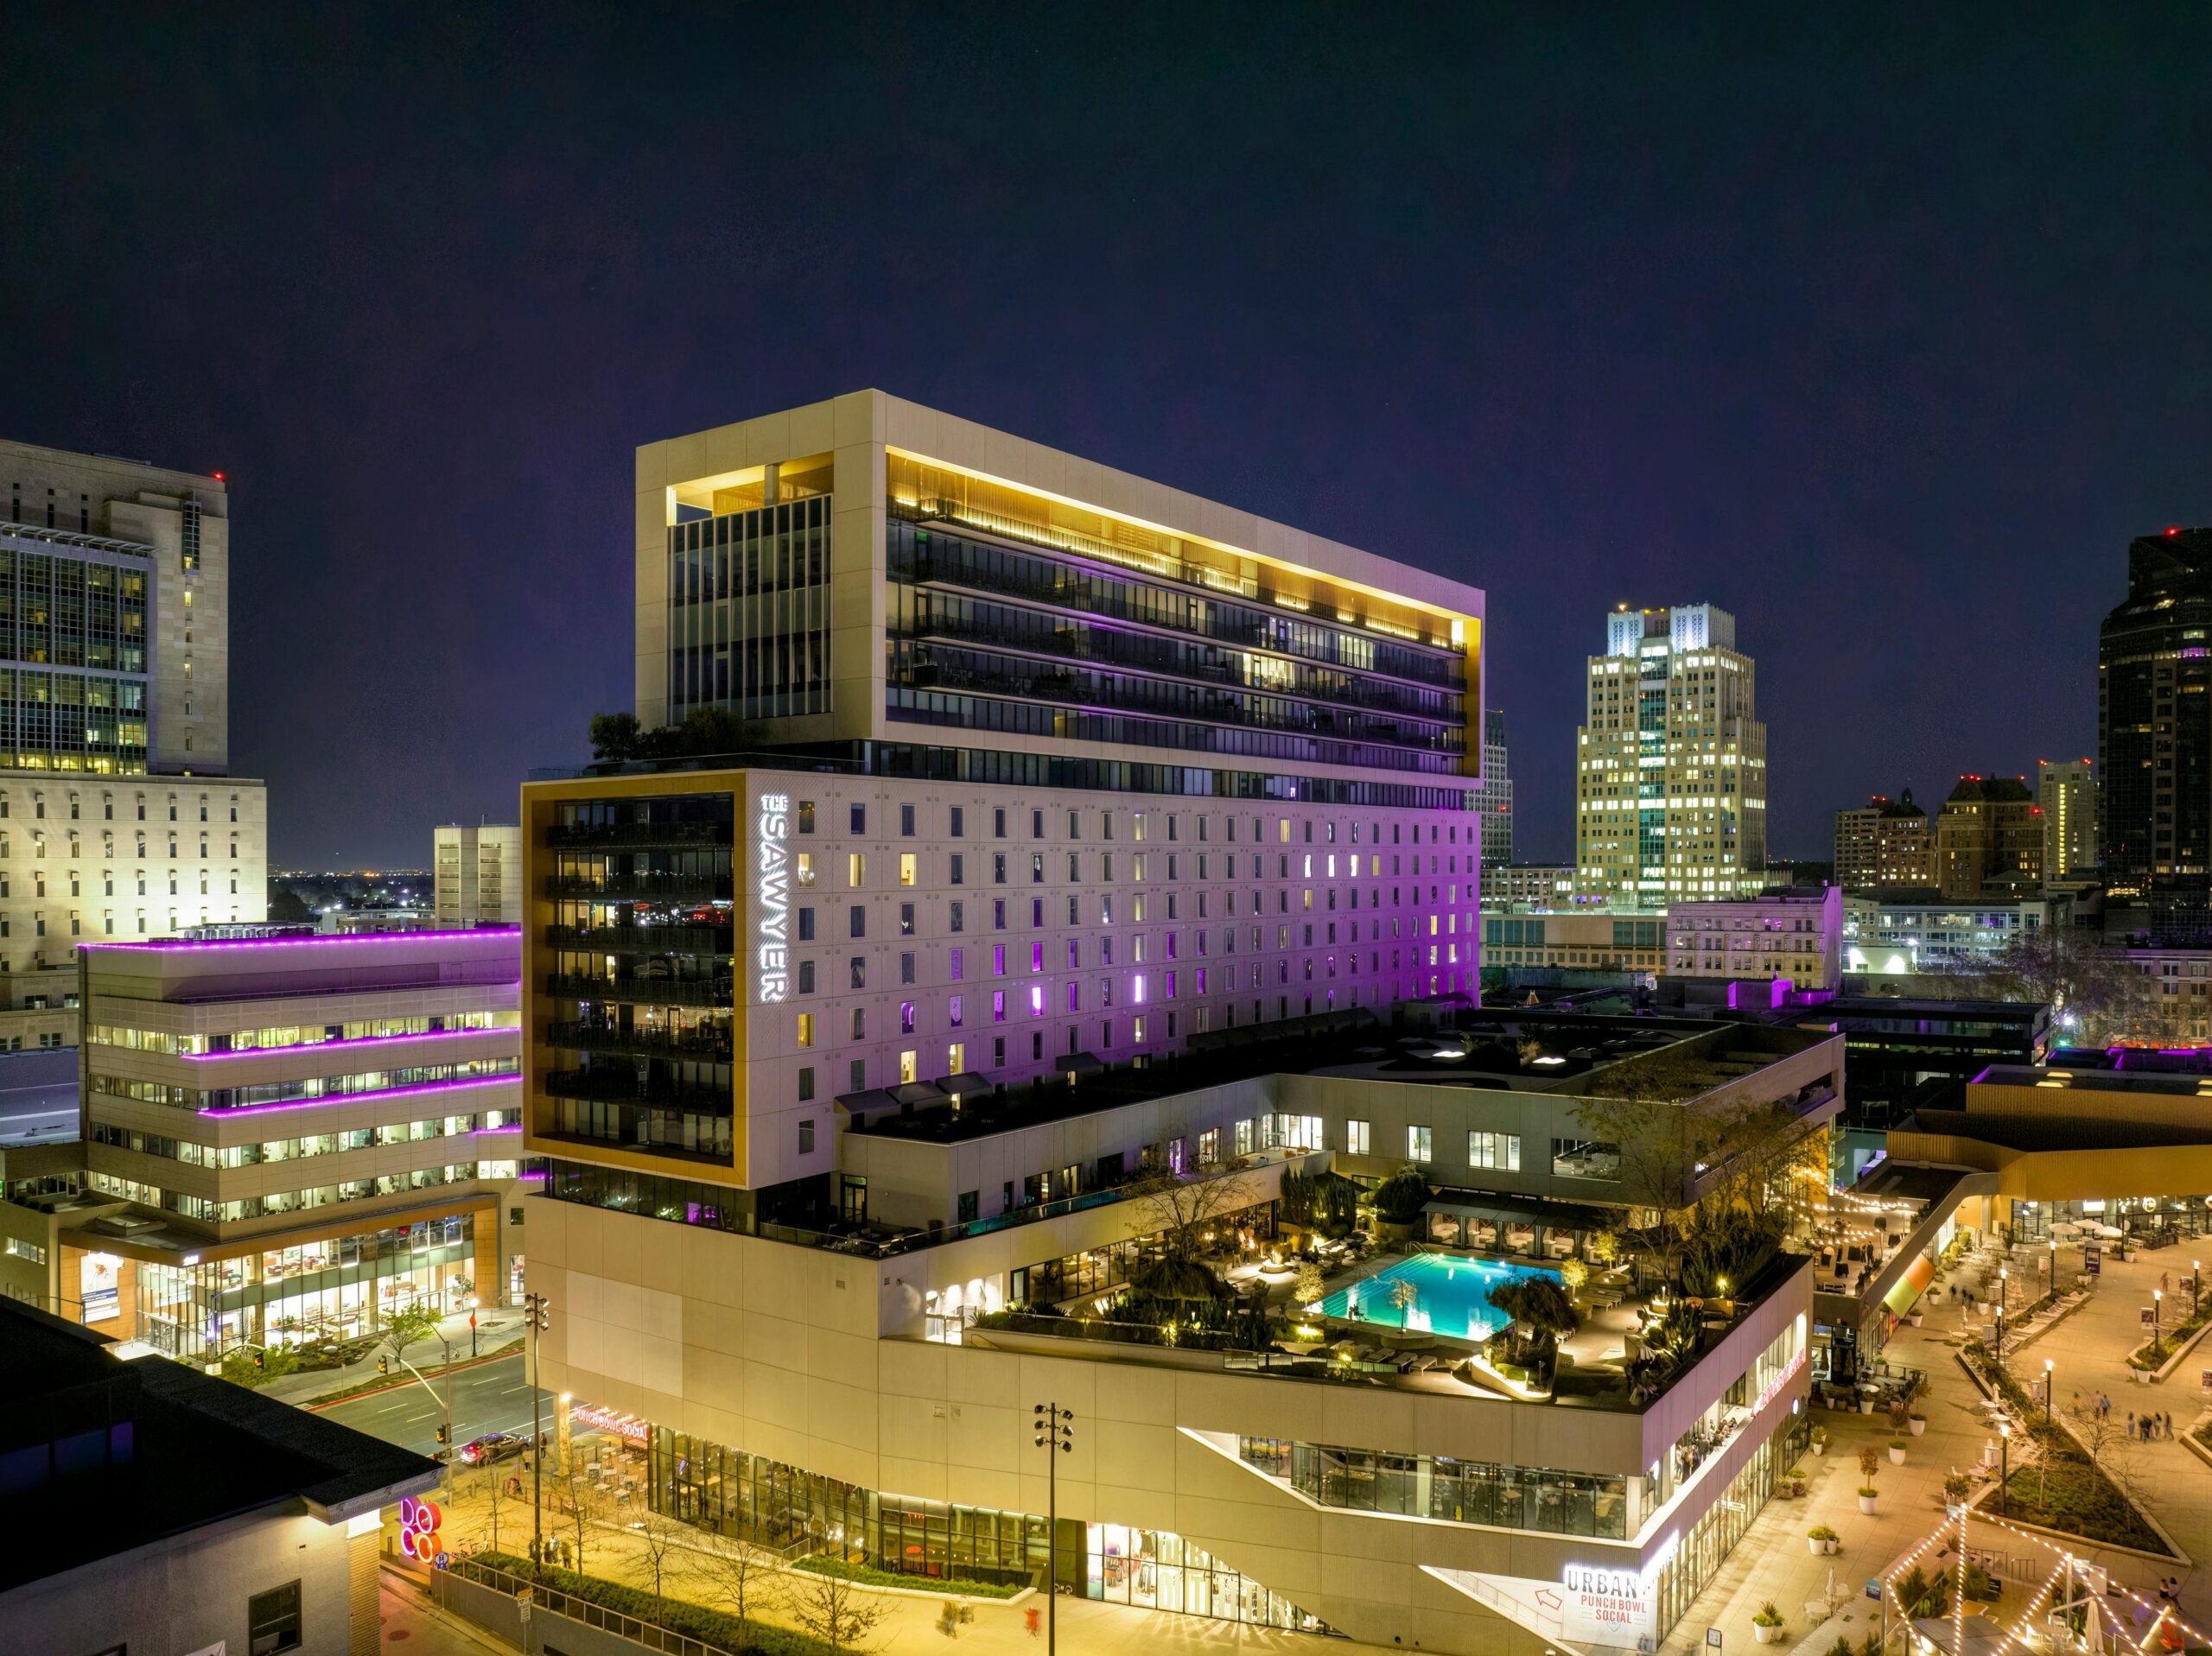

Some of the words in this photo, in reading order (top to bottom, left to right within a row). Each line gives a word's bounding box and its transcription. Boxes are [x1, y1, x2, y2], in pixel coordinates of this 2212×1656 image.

[763, 796, 788, 810] THE
[763, 814, 788, 1000] SAWYER
[575, 1407, 599, 1425] PUNCH
[599, 1415, 620, 1432] BOWL
[622, 1423, 648, 1441] SOCIAL
[1568, 1570, 1637, 1599] URBAN
[1580, 1595, 1616, 1610] PUNCH
[1618, 1599, 1647, 1614] BOWL
[1595, 1608, 1632, 1624] SOCIAL
